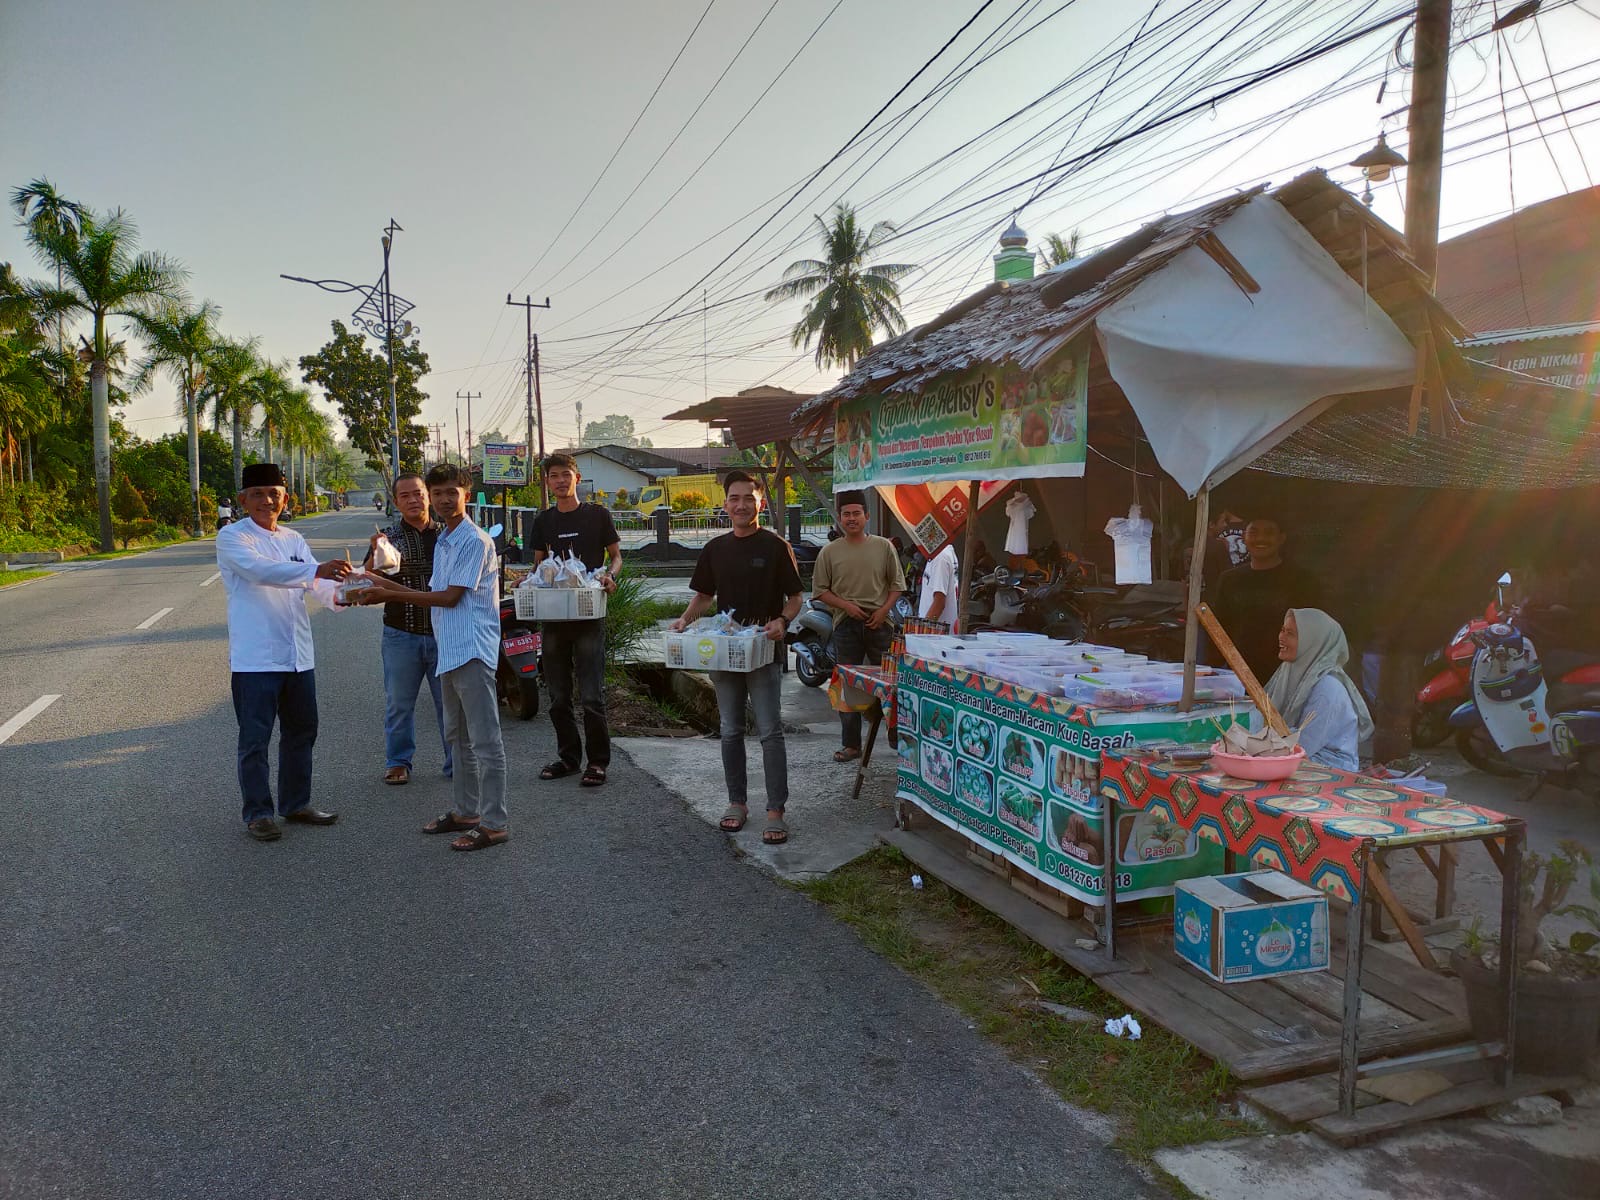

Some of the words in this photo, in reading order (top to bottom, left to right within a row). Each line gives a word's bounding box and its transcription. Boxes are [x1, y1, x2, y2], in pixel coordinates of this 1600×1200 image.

[1507, 358, 1537, 371] LEBIH
[1540, 352, 1585, 369] NIKMAT
[943, 497, 962, 518] 16
[914, 673, 947, 697] Menerima
[949, 684, 983, 710] Pesanan
[984, 695, 1055, 736] Macam-Macam
[1056, 720, 1079, 745] Kue
[1081, 727, 1135, 752] Basah
[990, 825, 1001, 839] PP
[1002, 832, 1037, 860] Bengkalis
[1061, 837, 1089, 861] Sakura
[1145, 844, 1176, 858] Pastel
